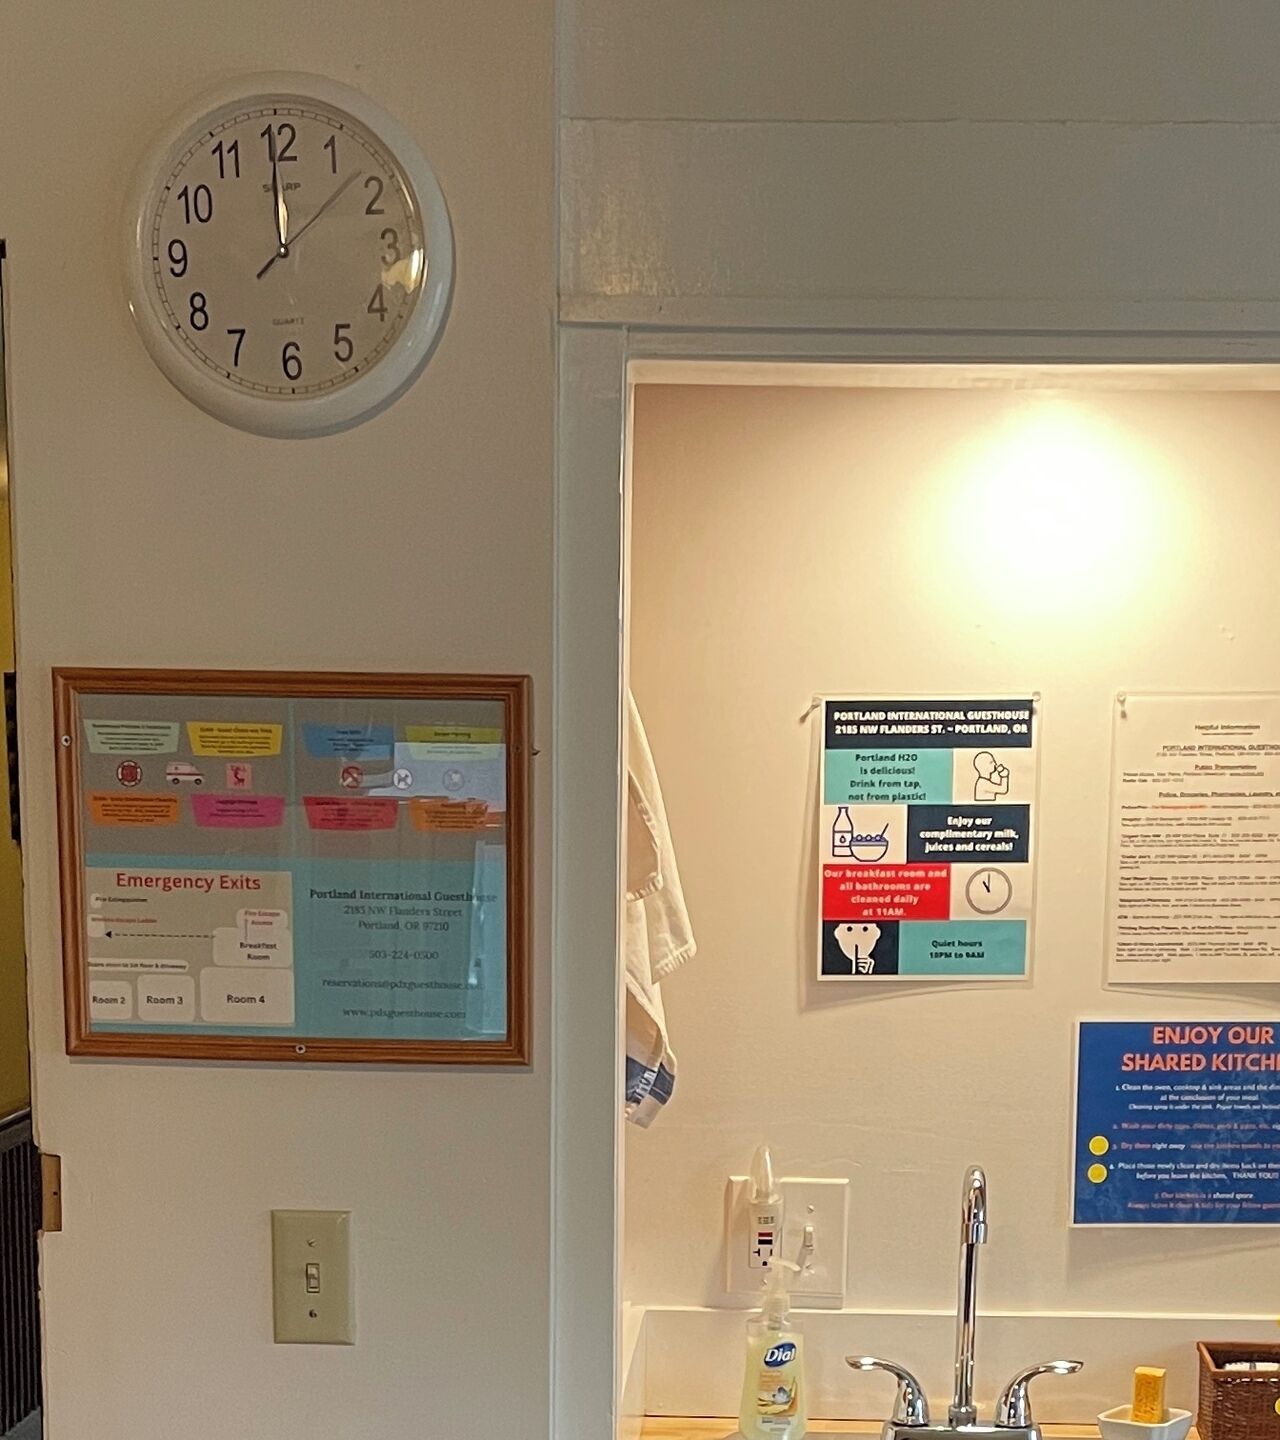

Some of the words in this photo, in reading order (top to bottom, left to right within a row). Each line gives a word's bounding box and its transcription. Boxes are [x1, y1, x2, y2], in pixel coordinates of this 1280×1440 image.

[260, 123, 298, 162] 12
[211, 139, 240, 179] 11
[323, 135, 337, 174] 1
[363, 175, 385, 215] 2
[177, 184, 213, 224] 10
[380, 227, 401, 266] 3
[167, 239, 188, 278] 9
[366, 284, 388, 322] 4
[189, 291, 209, 331] 8
[226, 328, 246, 367] 7
[333, 323, 354, 362] 5
[281, 341, 303, 381] 6
[833, 711, 886, 721] PORTLAND
[887, 710, 966, 720] INTERNATIONAL
[967, 710, 1030, 720] GUESTHOUSE
[835, 725, 858, 734] 2185
[859, 725, 878, 734] NW
[879, 725, 929, 734] FLANDERS
[930, 725, 945, 734] ST.
[954, 724, 1011, 735] PORTLAND,
[1012, 724, 1027, 733] OR
[855, 754, 896, 762] Portland
[898, 754, 918, 762] H2O
[860, 767, 870, 775] is
[871, 767, 916, 775] delicious!
[849, 780, 876, 788] Drink
[878, 780, 901, 788] from
[848, 793, 865, 801] not
[866, 793, 890, 801] from
[892, 793, 927, 802] plastic!
[947, 816, 973, 827] Enjoy
[920, 830, 992, 840] complimentary
[924, 842, 954, 853] juices
[955, 842, 973, 851] and
[975, 842, 1013, 851] cereals!
[823, 869, 844, 878] Our
[845, 869, 896, 878] breakfast
[927, 869, 948, 877] and
[116, 873, 215, 893] Emergency
[220, 875, 262, 890] Exits
[839, 883, 853, 891] all
[855, 883, 911, 891] bathrooms
[912, 883, 931, 891] are
[309, 889, 357, 899] Portland
[359, 890, 431, 901] International
[850, 895, 891, 904] cleaned
[893, 895, 919, 905] daily
[389, 906, 431, 916] Flanders
[433, 907, 463, 917] Street
[862, 908, 875, 916] at
[239, 942, 277, 950] Breakfast
[931, 940, 956, 948] Quiet
[957, 940, 983, 948] hours
[92, 996, 119, 1004] Room
[120, 996, 126, 1004] 2
[146, 995, 176, 1004] Room
[177, 995, 184, 1004] 3
[226, 995, 255, 1003] Room
[258, 995, 265, 1003] 4
[1152, 1026, 1222, 1045] ENJOY
[1227, 1026, 1275, 1045] OUR
[1121, 1053, 1207, 1071] SHARED
[765, 1348, 796, 1363] Dial
